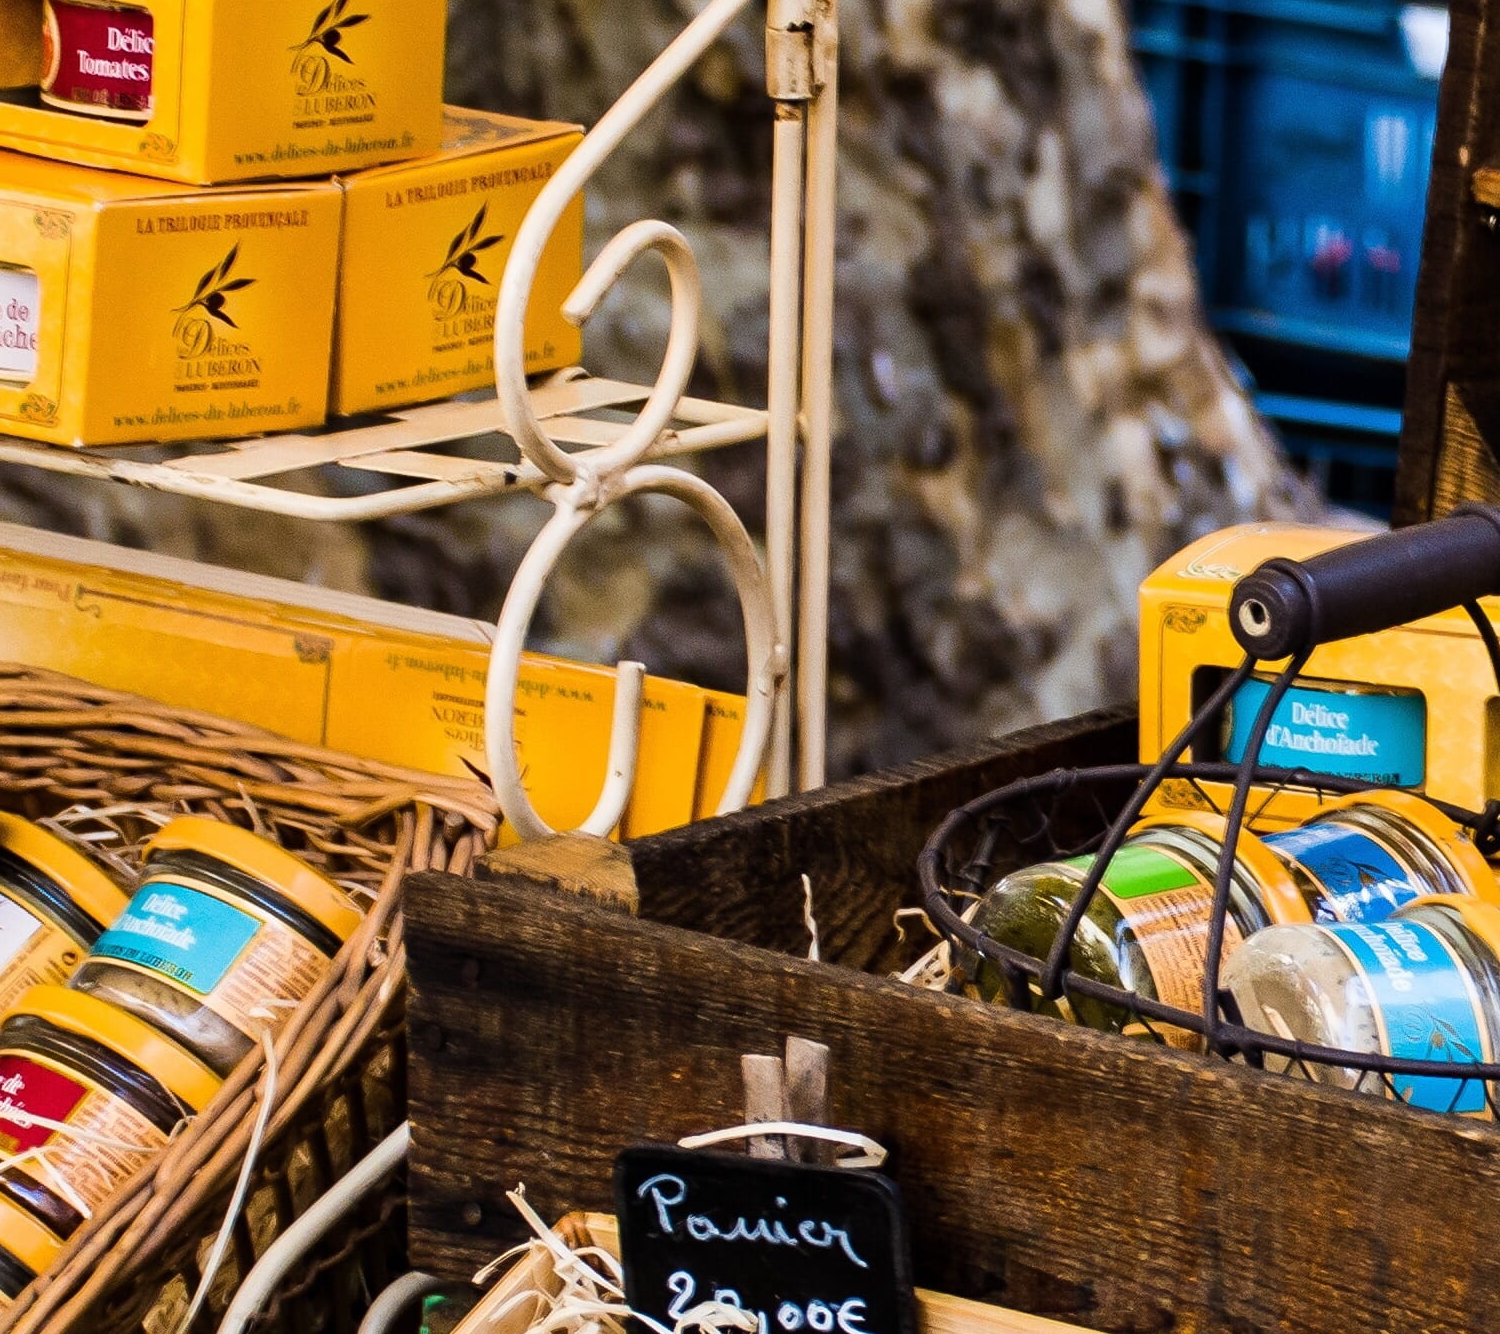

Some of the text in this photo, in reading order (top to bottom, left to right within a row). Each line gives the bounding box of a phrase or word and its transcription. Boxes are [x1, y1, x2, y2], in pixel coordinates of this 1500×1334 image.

[77, 50, 149, 82] Tomates
[1291, 701, 1349, 728] Délice
[637, 1173, 868, 1268] Panier
